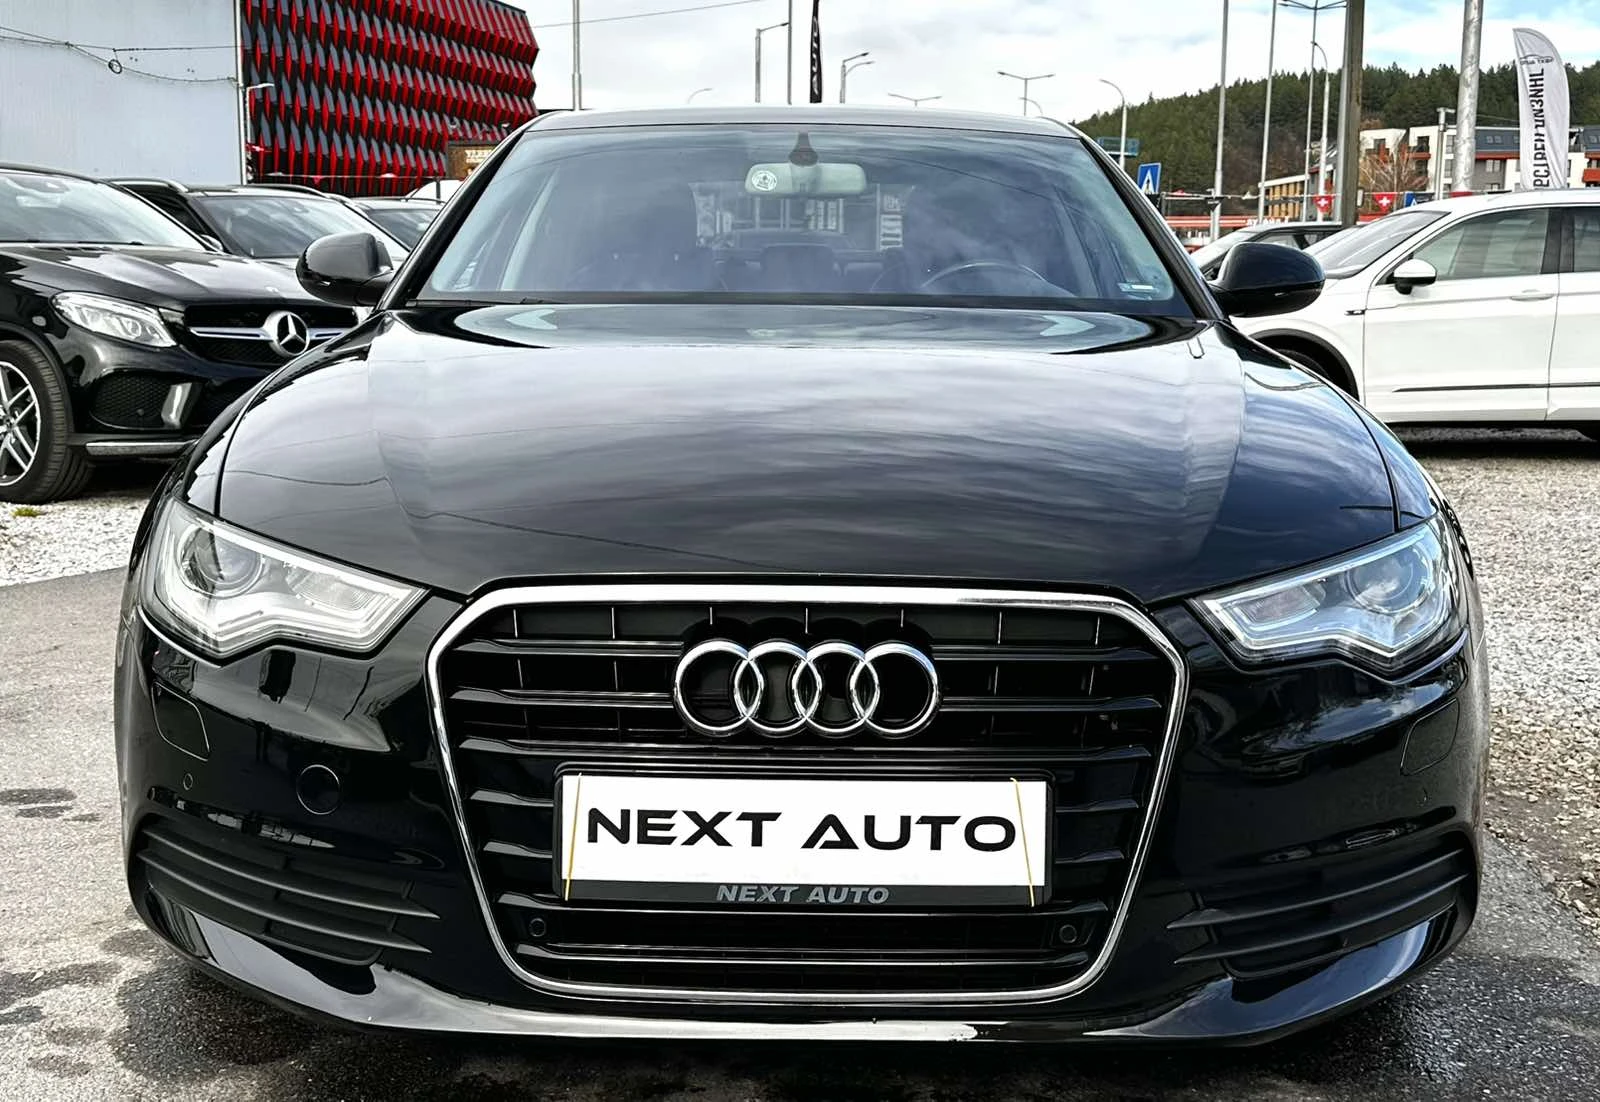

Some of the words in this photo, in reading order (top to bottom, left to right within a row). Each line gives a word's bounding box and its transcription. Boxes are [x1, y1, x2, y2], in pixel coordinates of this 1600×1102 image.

[587, 807, 782, 847] NEXT
[800, 813, 1016, 852] AUTO
[716, 885, 799, 903] NEXT
[805, 886, 890, 904] AUTO
